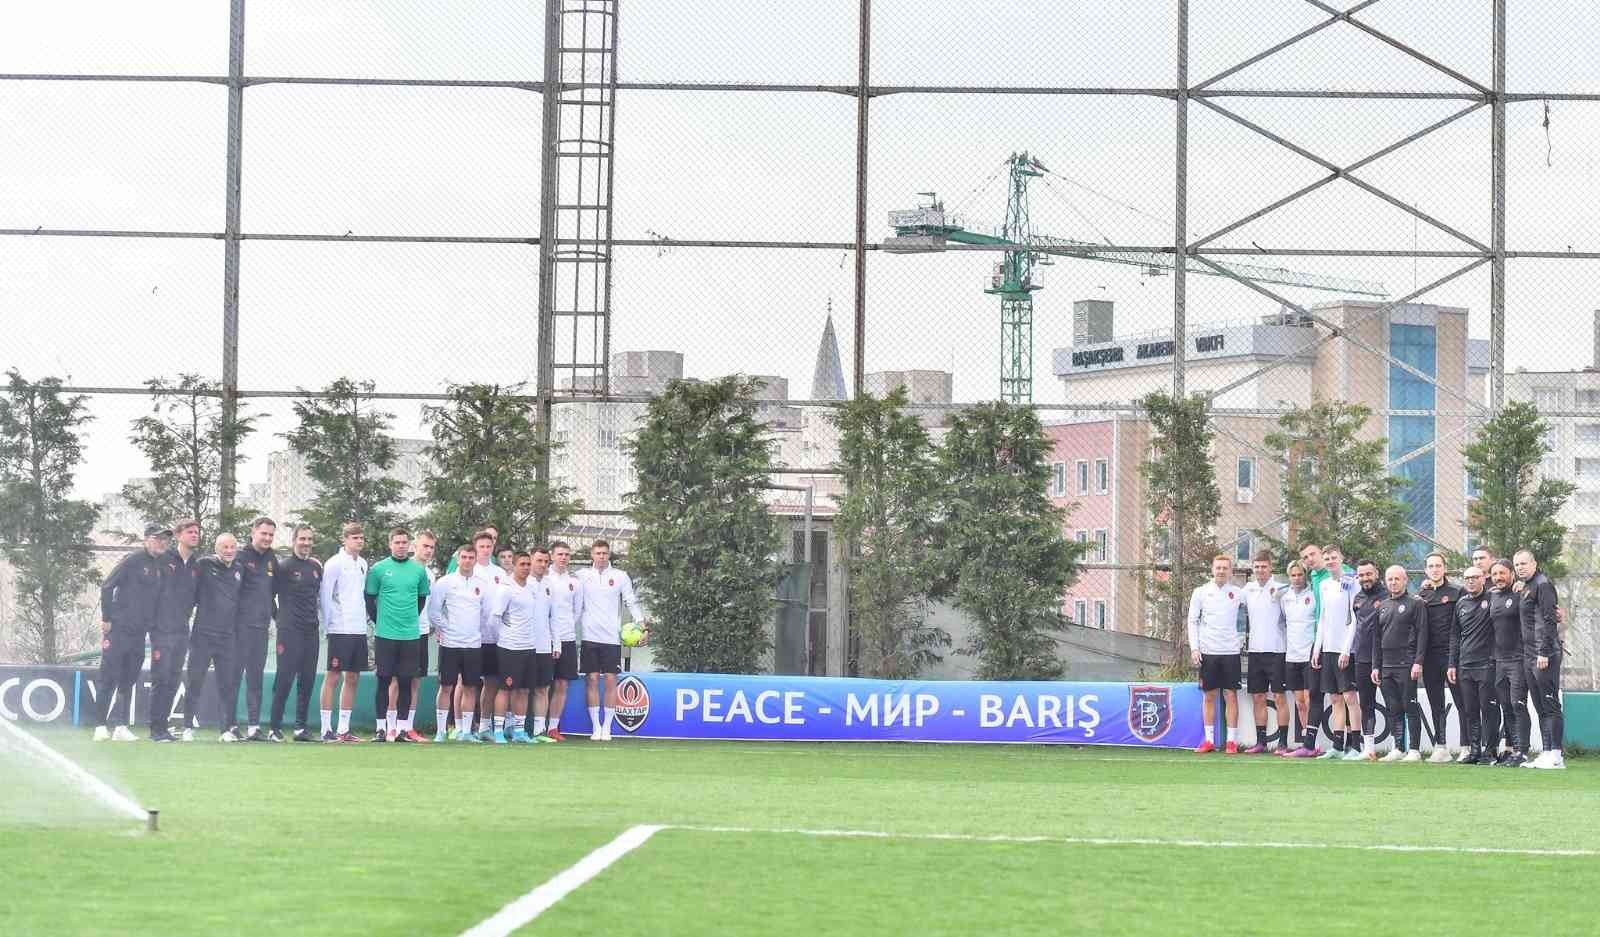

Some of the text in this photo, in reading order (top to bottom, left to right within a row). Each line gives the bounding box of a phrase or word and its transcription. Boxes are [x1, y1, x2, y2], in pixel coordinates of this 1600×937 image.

[675, 688, 806, 725] PEACE
[845, 693, 940, 727] МИР
[979, 694, 1101, 738] BARIŞ
